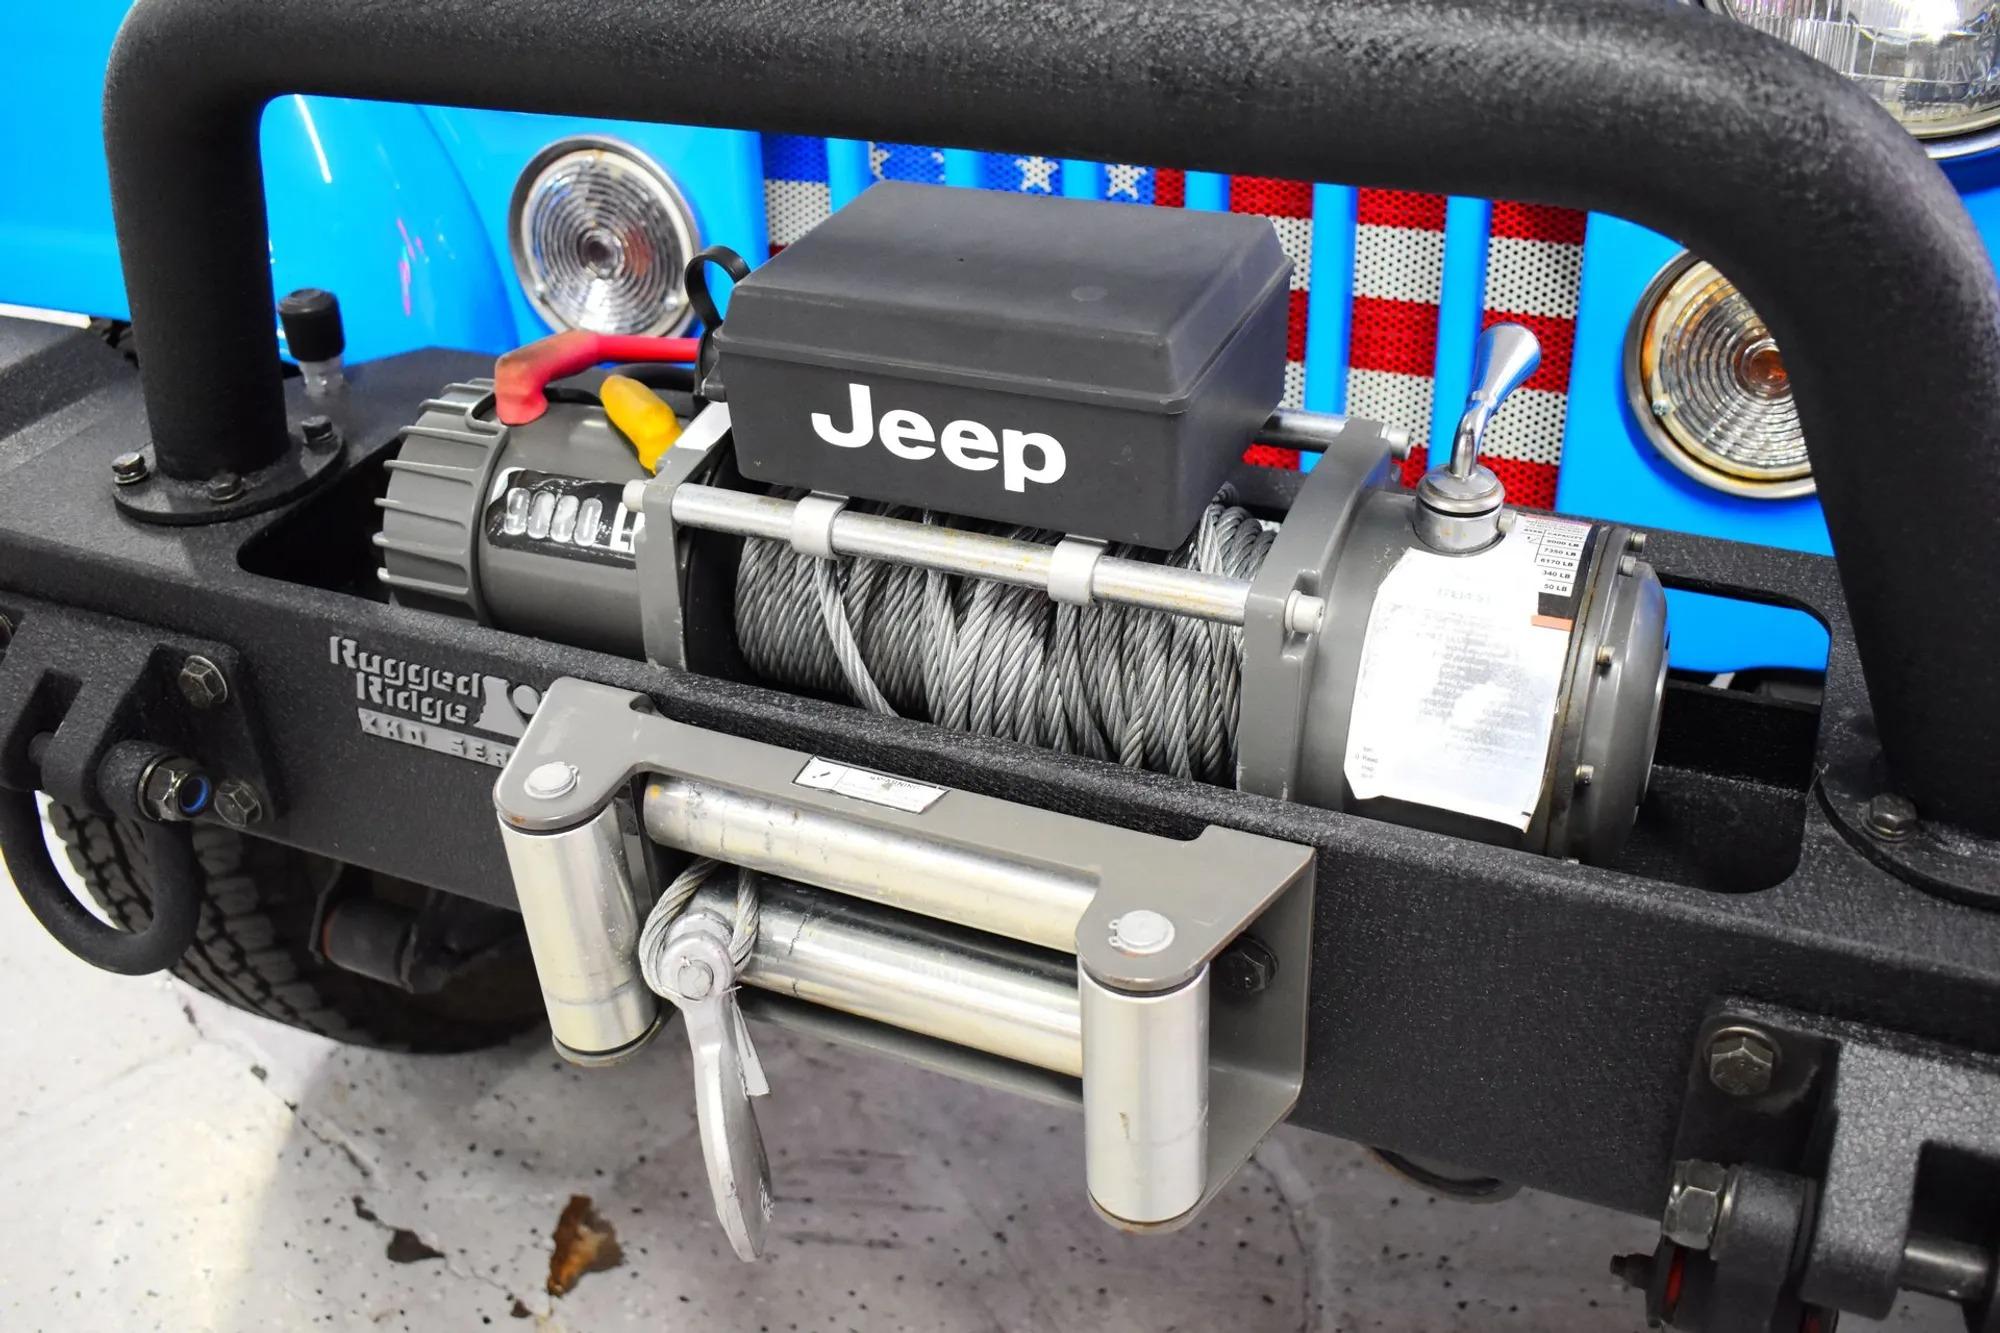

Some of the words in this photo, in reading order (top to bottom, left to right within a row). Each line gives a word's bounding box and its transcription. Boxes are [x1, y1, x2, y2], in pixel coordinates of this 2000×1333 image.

[811, 383, 1067, 492] Jeep
[1560, 571, 1570, 579] LB
[329, 636, 481, 699] Rugged
[356, 671, 468, 725] Ridge
